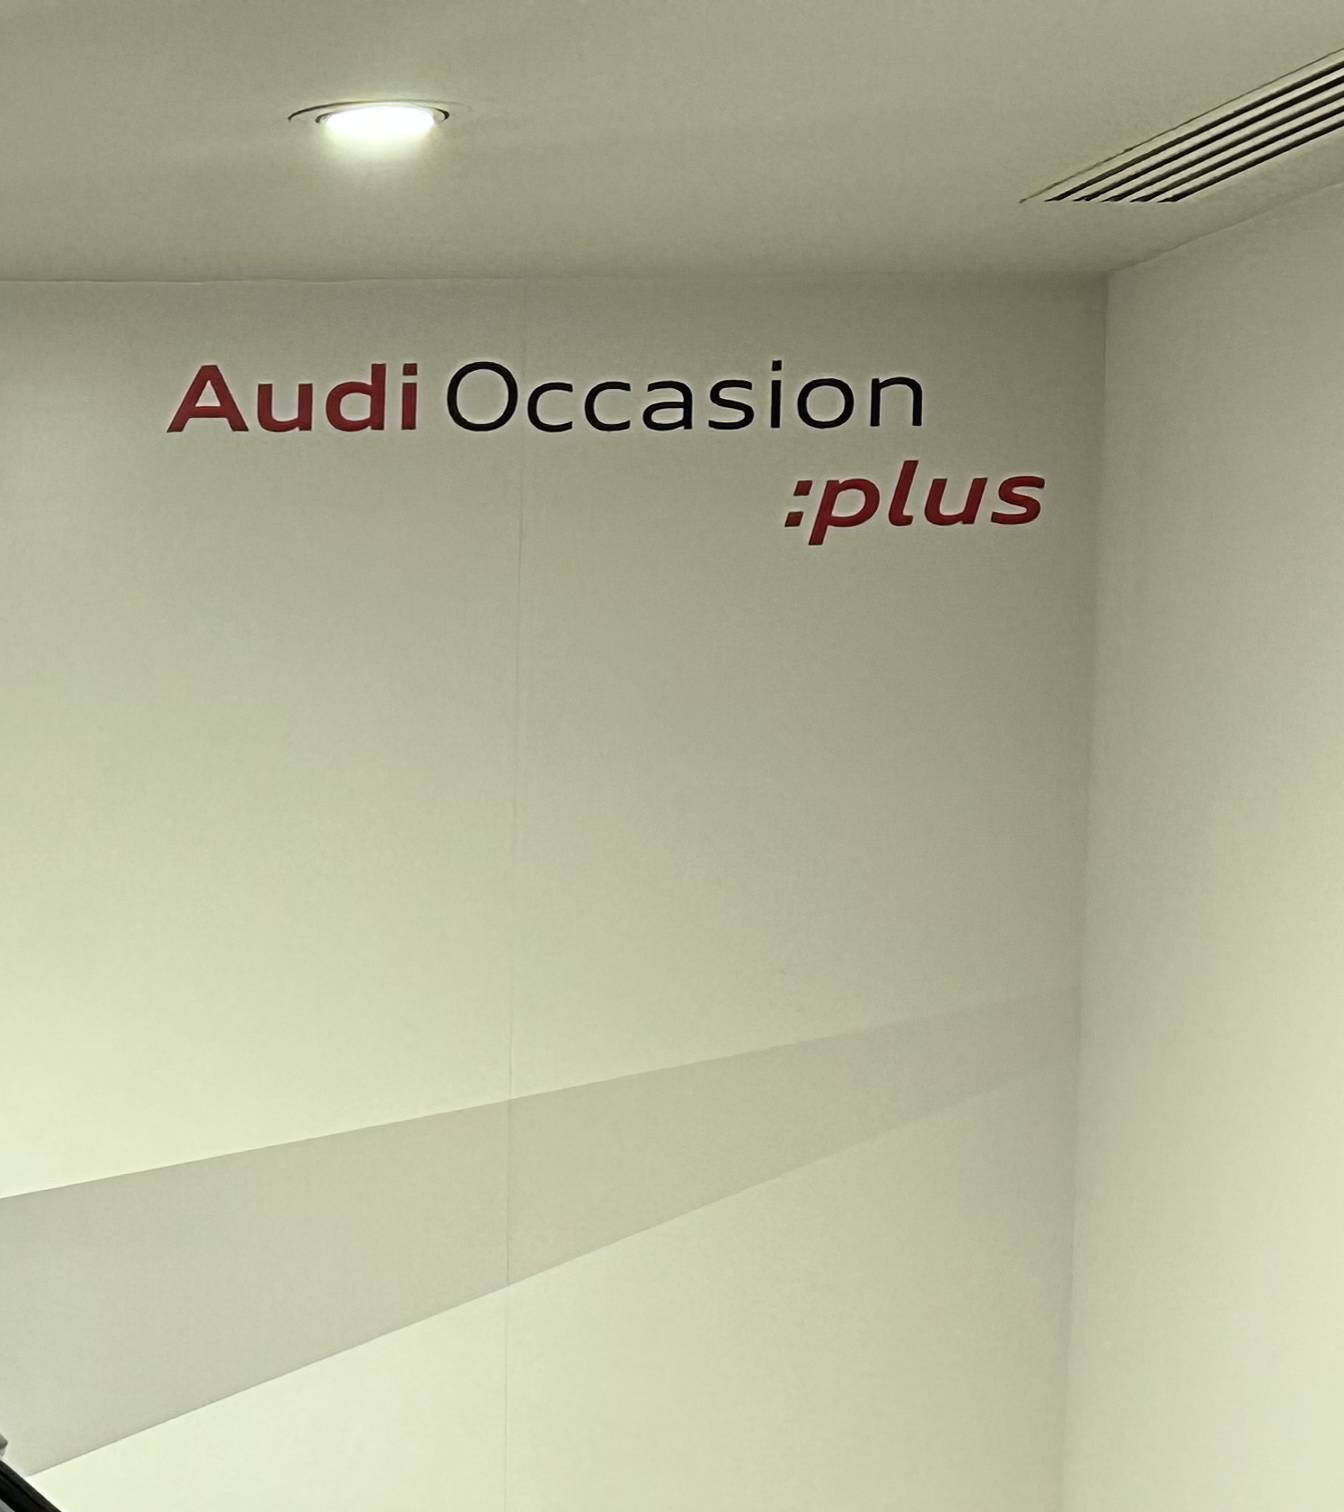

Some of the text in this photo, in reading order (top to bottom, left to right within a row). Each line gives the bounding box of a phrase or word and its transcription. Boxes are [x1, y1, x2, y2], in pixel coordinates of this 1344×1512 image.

[167, 360, 923, 432] Audi Occasion
[784, 460, 1045, 545] :plus
